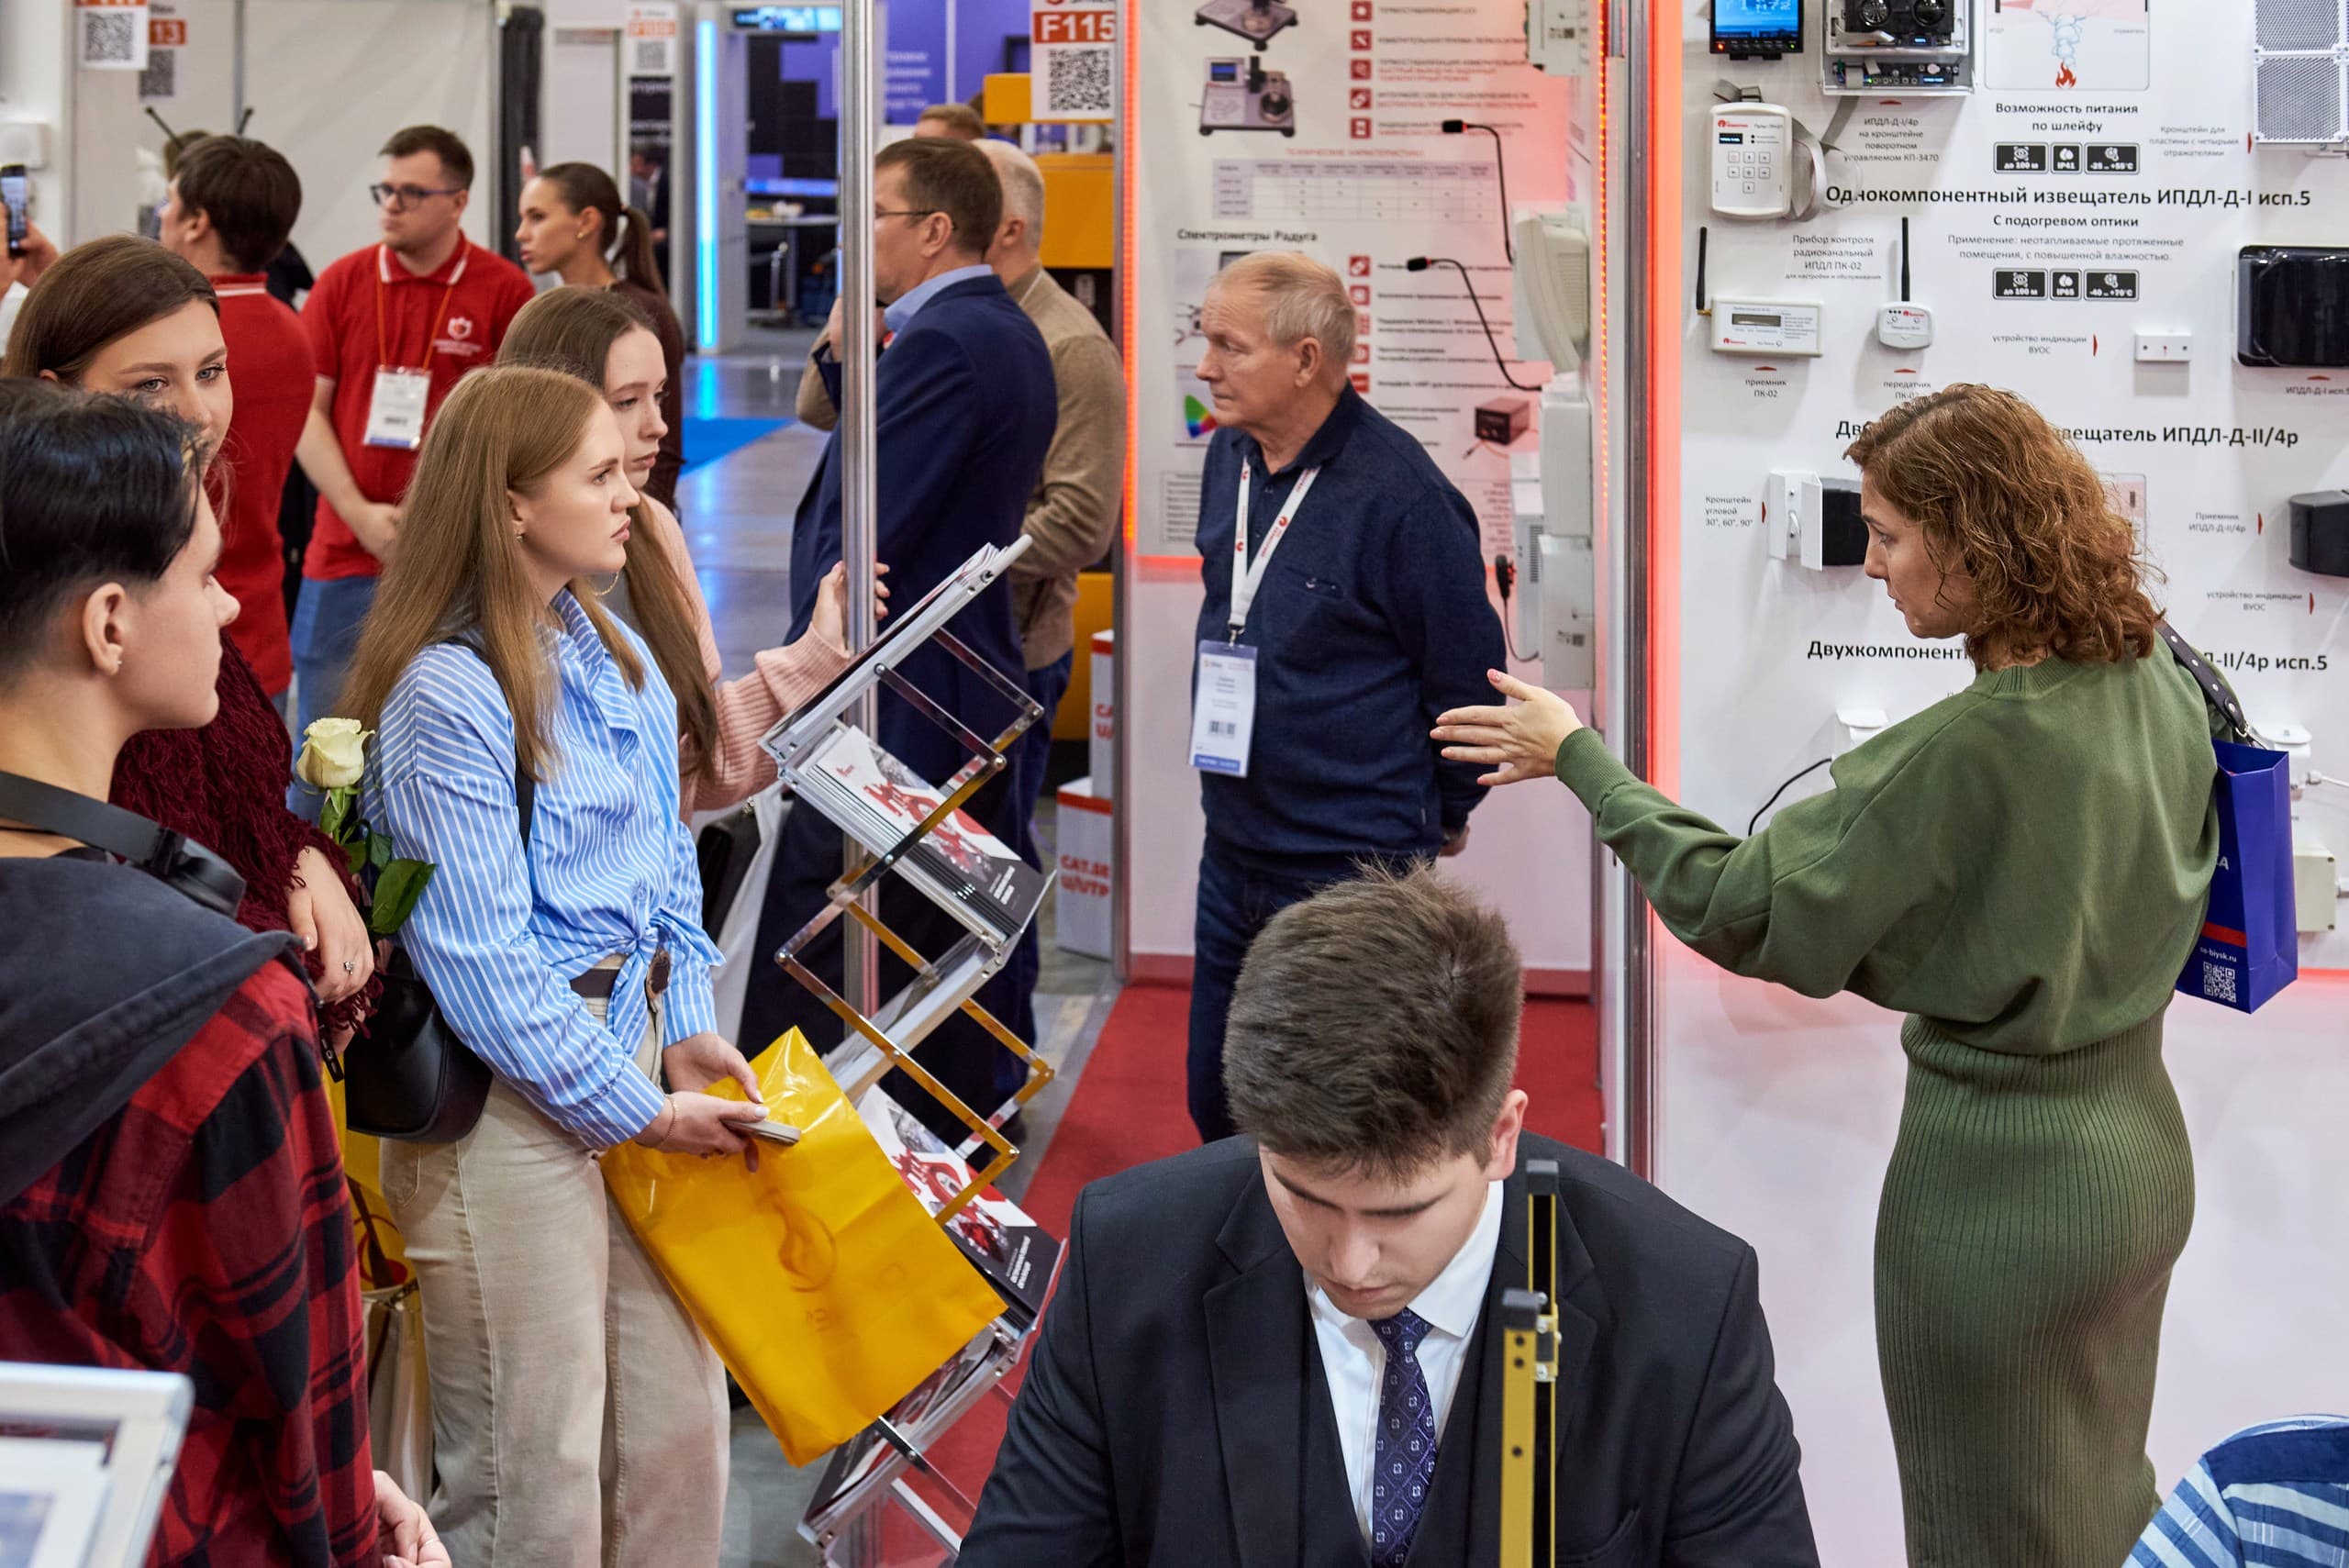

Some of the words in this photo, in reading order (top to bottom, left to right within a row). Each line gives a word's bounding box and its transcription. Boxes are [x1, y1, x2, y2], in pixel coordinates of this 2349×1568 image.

[1041, 14, 1115, 41] F115
[1996, 102, 2083, 117] Возможность
[2086, 105, 2139, 116] питания
[1864, 117, 1920, 128] ИПДЛ-Д-I/4р
[2032, 122, 2047, 131] по
[2051, 119, 2103, 134] шлейфу
[1859, 130, 1870, 139] на
[1873, 128, 1924, 139] кронштейне
[2160, 125, 2208, 135] Кронштейн
[1865, 143, 1919, 151] поворотном
[2198, 139, 2240, 147] четырьмя
[2163, 150, 2225, 158] отражателями
[2016, 161, 2031, 170] 100
[2056, 161, 2076, 170] IP41
[1825, 184, 2027, 206] Однокомпонентный
[2033, 191, 2152, 207] извещатель
[2157, 189, 2252, 208] ИПДЛ-Д-I
[2258, 190, 2311, 206] исп.5
[1993, 214, 2002, 227] С
[2005, 217, 2087, 228] подогревом
[2091, 217, 2139, 228] оптики
[1177, 228, 1271, 243] Спектрометры
[1274, 229, 1318, 244] Радуга
[1792, 235, 1830, 245] Прибор
[1831, 236, 1875, 244] контроля
[1947, 234, 2018, 246] Применение:
[2020, 237, 2110, 246] неотапливаемые
[2112, 239, 2185, 249] протяженные
[1793, 248, 1874, 258] радиоканальный
[1959, 250, 2024, 261] помещения,
[2034, 250, 2103, 260] повышенной
[2105, 252, 2172, 261] влажностью.
[1804, 261, 1832, 272] ИПДЛ
[1834, 261, 1863, 271] ПК-02
[2015, 288, 2030, 296] 100
[2056, 288, 2075, 296] IP65
[1992, 333, 2039, 343] устройство
[2041, 335, 2087, 343] индикации
[2028, 345, 2052, 355] ВУОС
[1745, 379, 1787, 388] приемник
[1883, 382, 1932, 390] передатчик
[1753, 389, 1778, 398] ПК-02
[2062, 426, 2157, 444] вещатель
[2163, 426, 2299, 448] ИПДЛ-Д-II/4р
[1705, 496, 1752, 505] Кронштейн
[1705, 507, 1738, 516] угловой
[2195, 512, 2240, 521] Приемник
[2206, 590, 2254, 599] устройство
[2254, 593, 2303, 601] индикации
[2243, 603, 2266, 612] ВУОС
[1807, 640, 1967, 661] Двухкомпонент
[2204, 651, 2269, 673] -II/4р
[2276, 655, 2328, 672] исп.5
[2199, 947, 2237, 962] -biysk.ru
